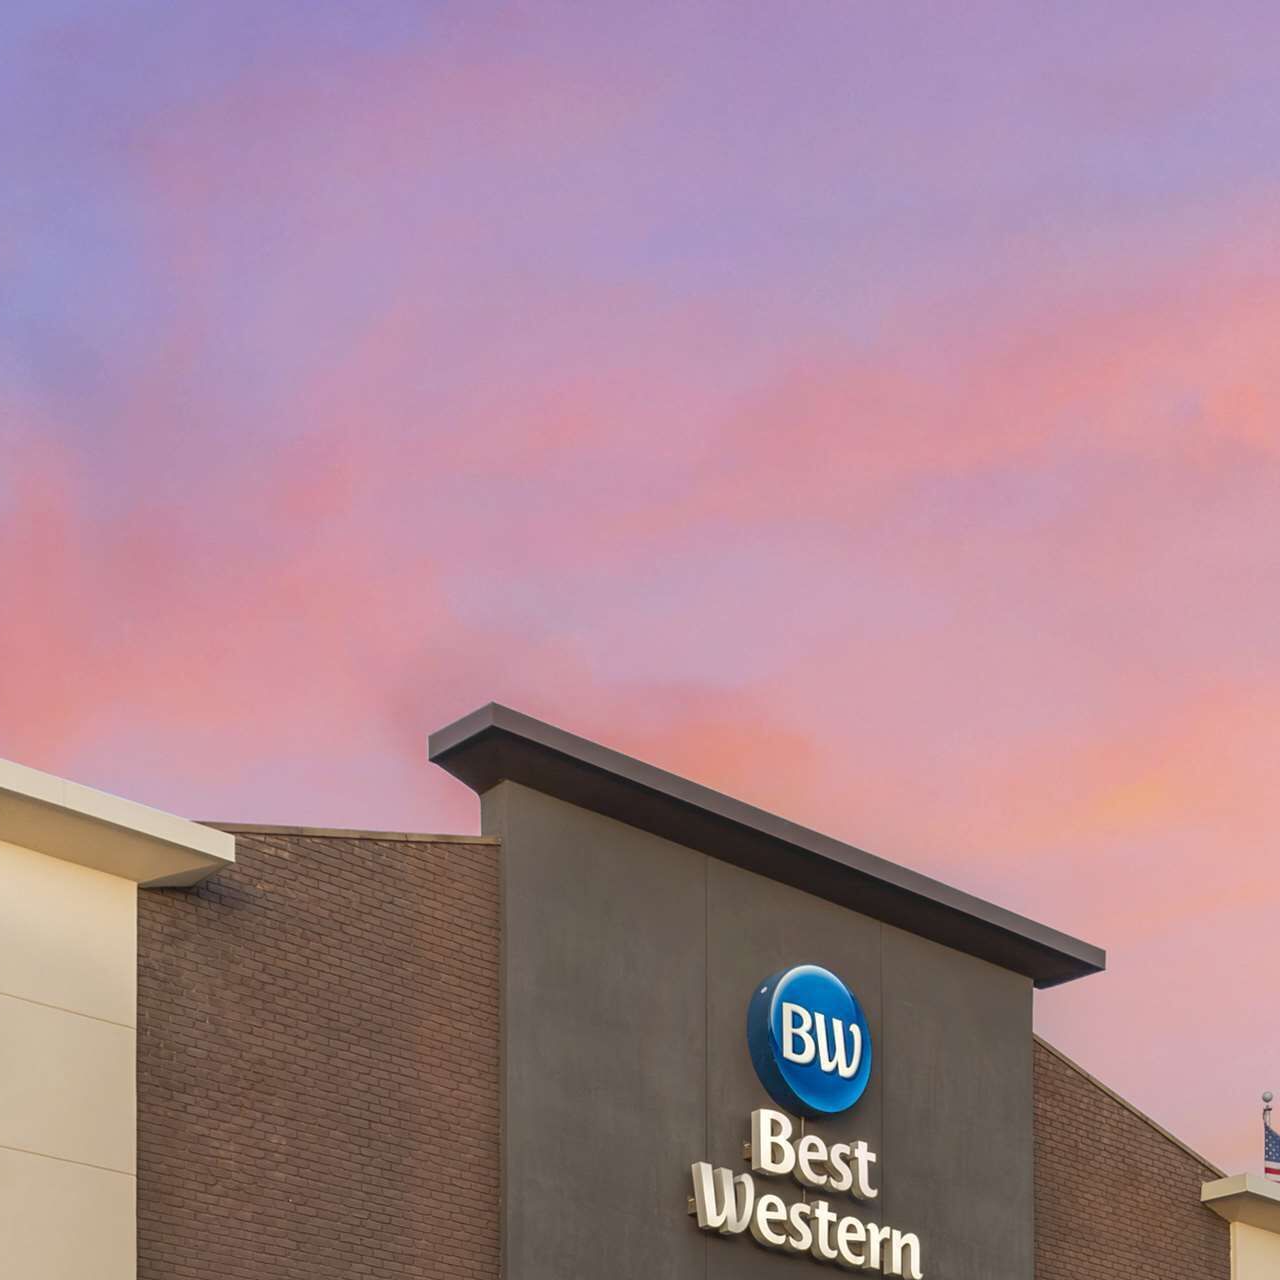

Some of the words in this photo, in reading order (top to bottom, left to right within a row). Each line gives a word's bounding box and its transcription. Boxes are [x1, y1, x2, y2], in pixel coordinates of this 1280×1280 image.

[781, 1001, 863, 1079] BW
[751, 1108, 878, 1199] Best
[691, 1161, 924, 1280] Western
